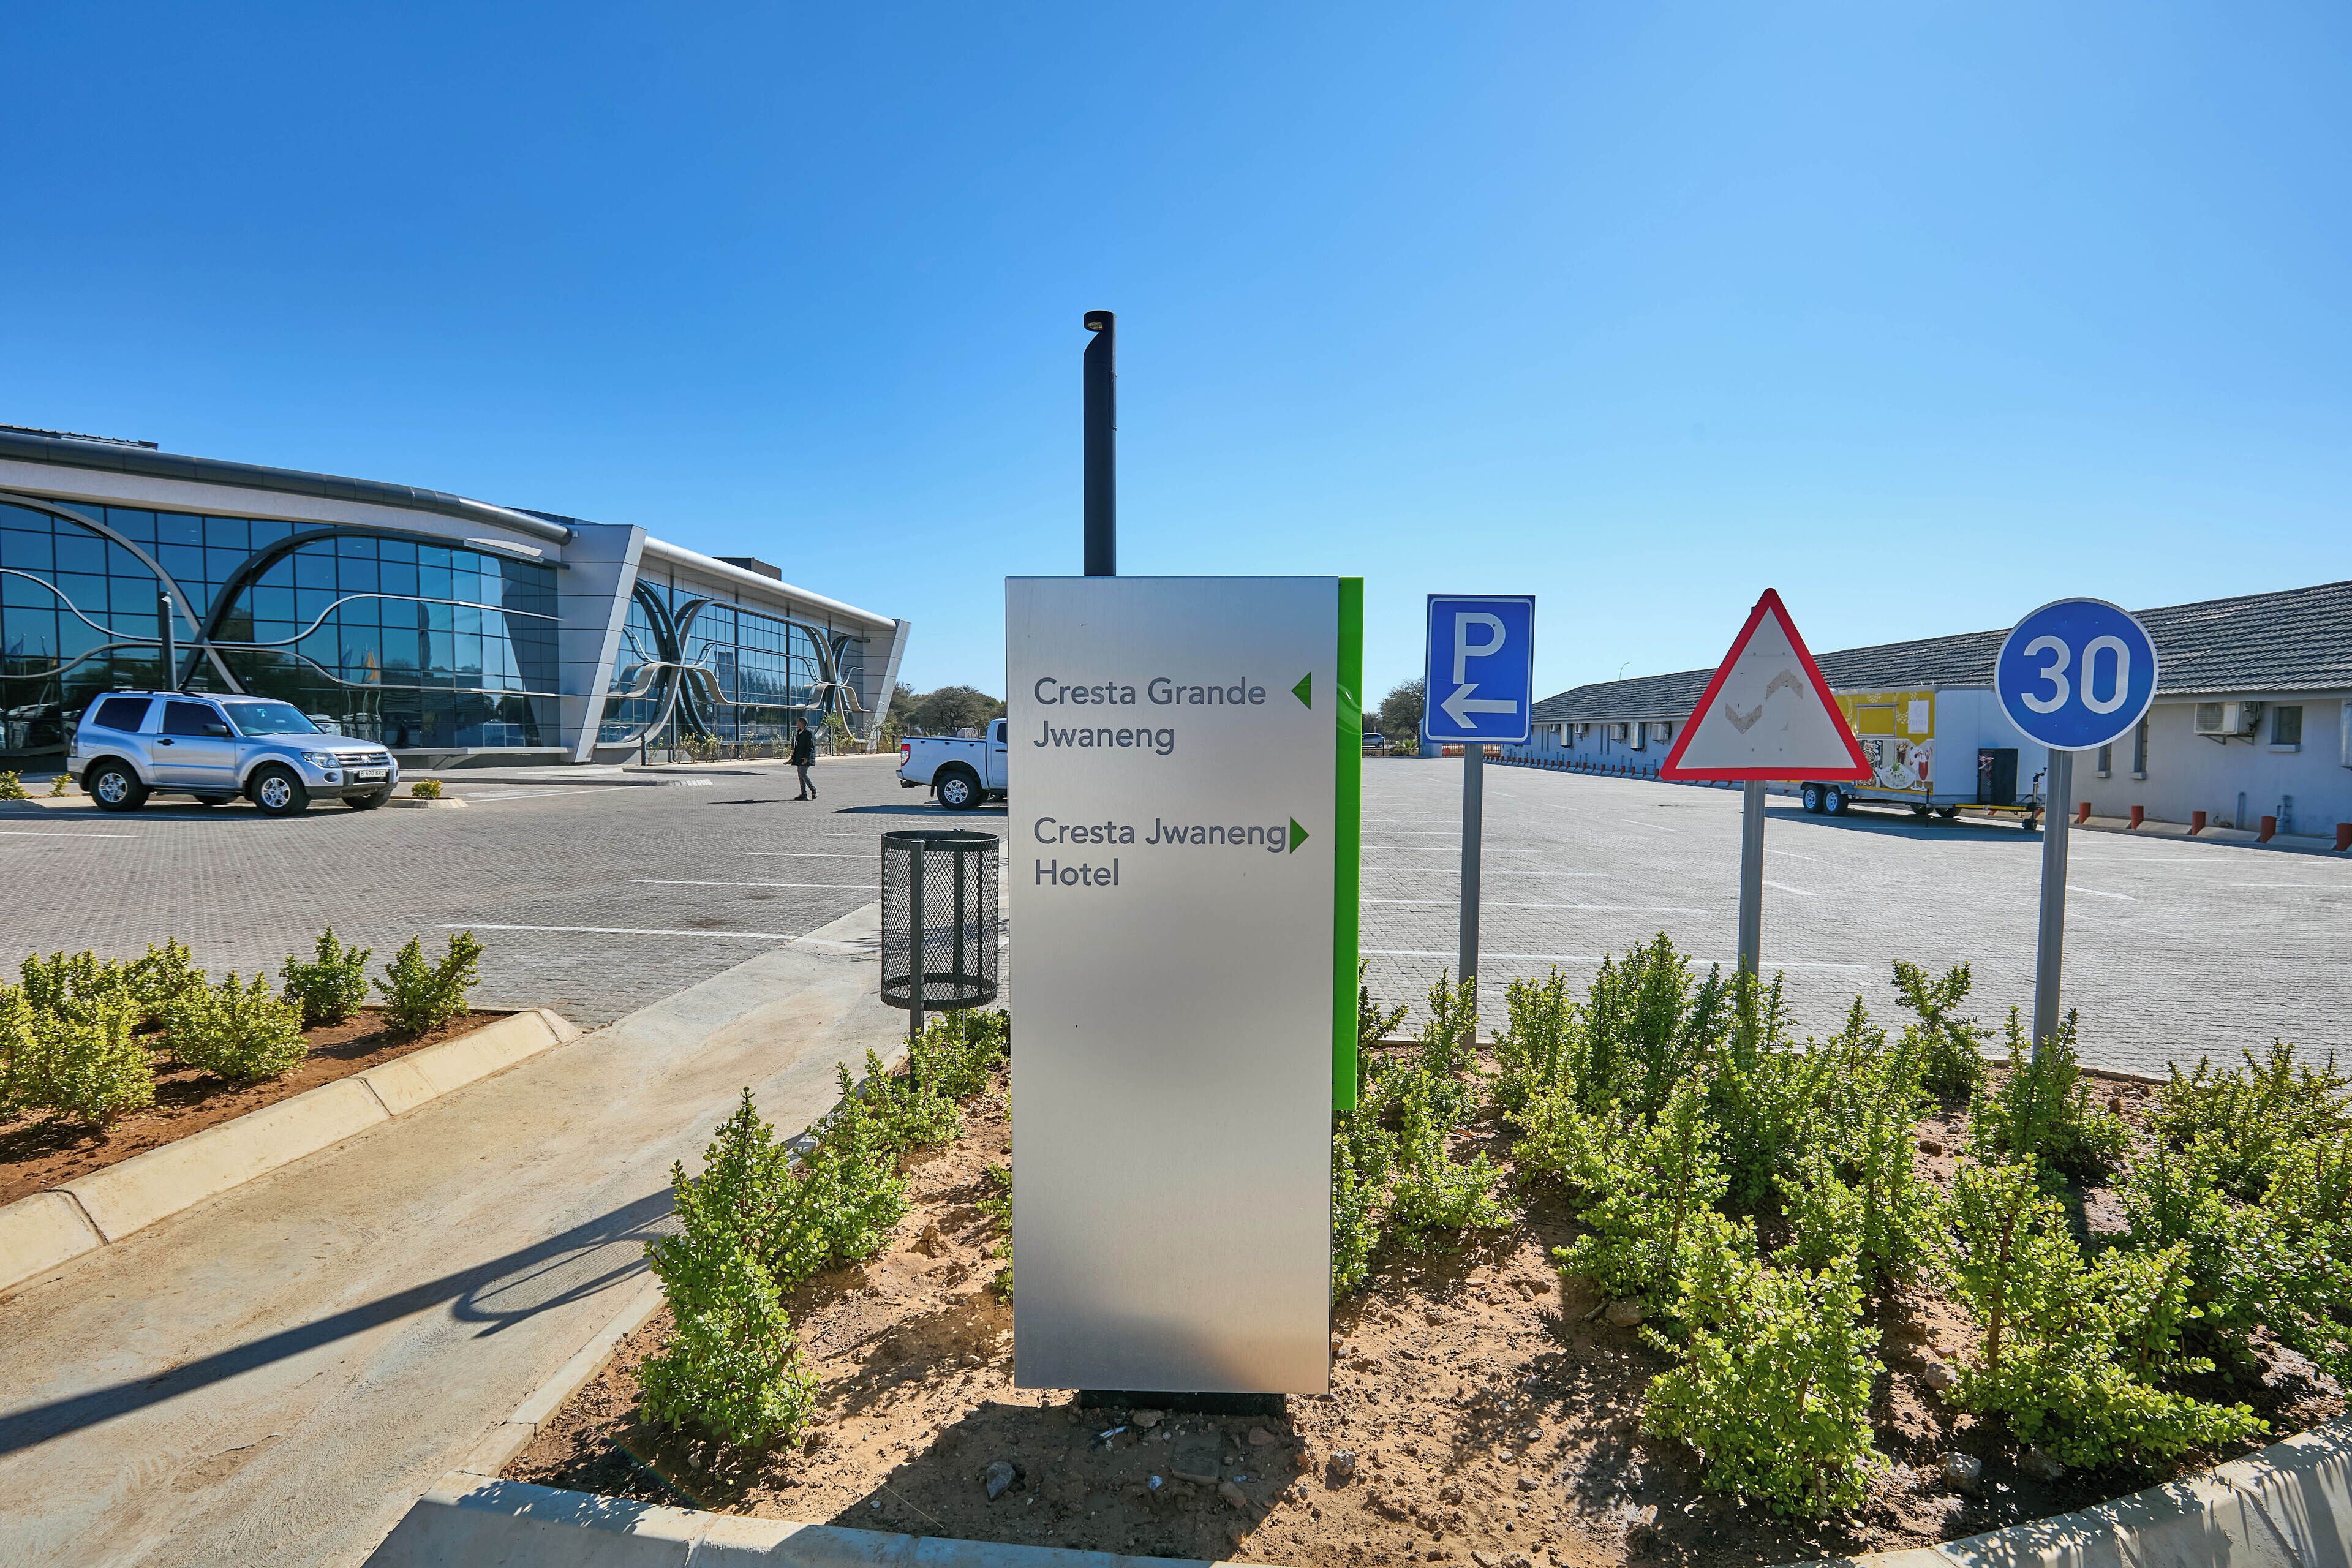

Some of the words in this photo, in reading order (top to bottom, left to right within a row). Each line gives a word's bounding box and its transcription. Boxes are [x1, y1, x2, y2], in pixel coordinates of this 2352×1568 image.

[1453, 612, 1506, 684] P
[1034, 677, 1136, 705] Cresta
[1147, 676, 1266, 706] Grande
[2021, 635, 2130, 714] 30
[1033, 720, 1175, 756] Jwaneng
[1034, 816, 1135, 845] Cresta
[1145, 818, 1286, 853] Jwaneng
[1035, 858, 1119, 886] Hotel
